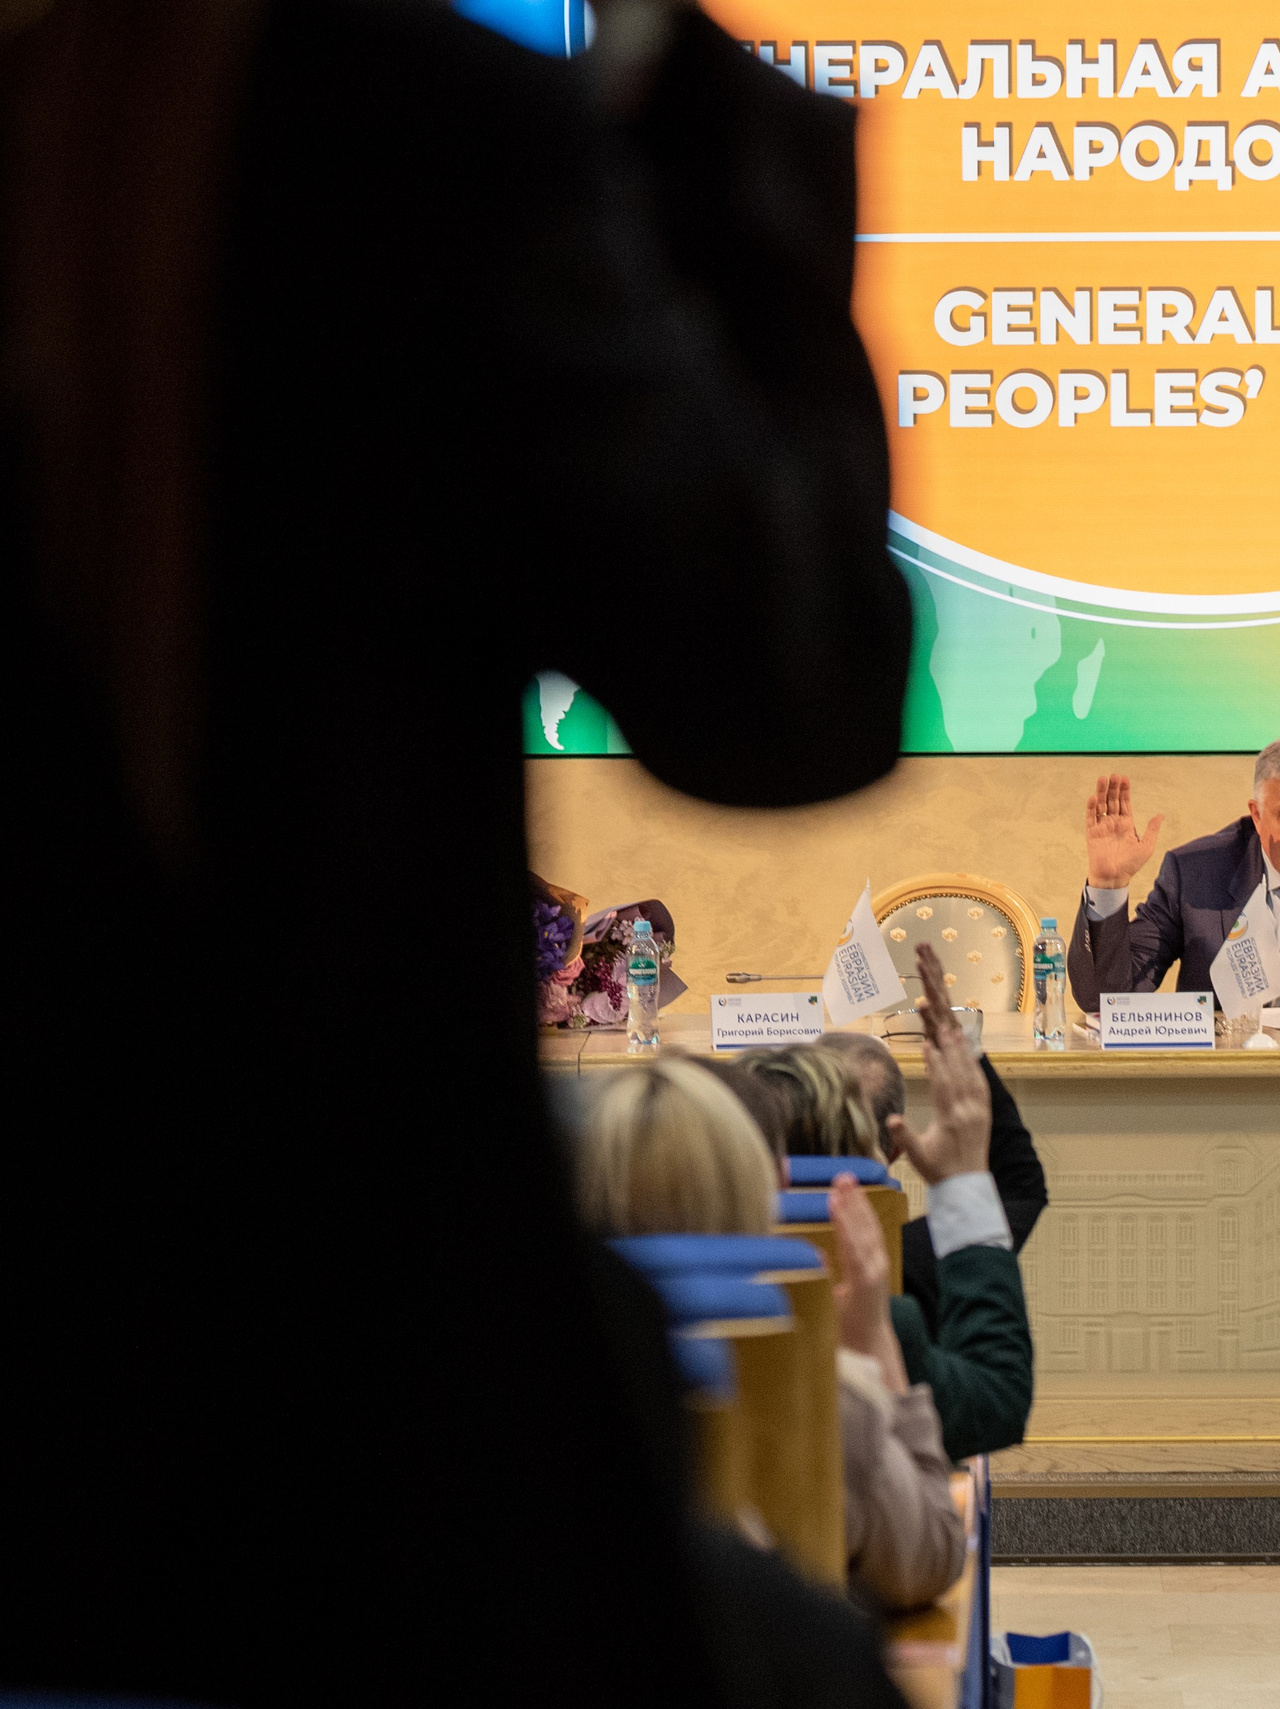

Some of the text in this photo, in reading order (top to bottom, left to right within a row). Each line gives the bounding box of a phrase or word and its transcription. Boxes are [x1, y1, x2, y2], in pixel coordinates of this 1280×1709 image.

[742, 38, 1221, 99] НЕРАЛЬНАЯ
[898, 365, 1265, 428] PEOPLES'
[839, 948, 865, 1003] EURASIAN
[847, 944, 875, 999] ЕВРАЗИИ
[1232, 943, 1256, 997] EURASIAN
[1241, 939, 1265, 992] ЕВРАЗИИ
[717, 1027, 822, 1038] Григорий Борисович
[737, 1013, 799, 1023] КАРАСИН
[1108, 1025, 1207, 1037] Андрей Юрьевич
[1112, 1011, 1203, 1023] БЕЛЬЯНИНОВ
